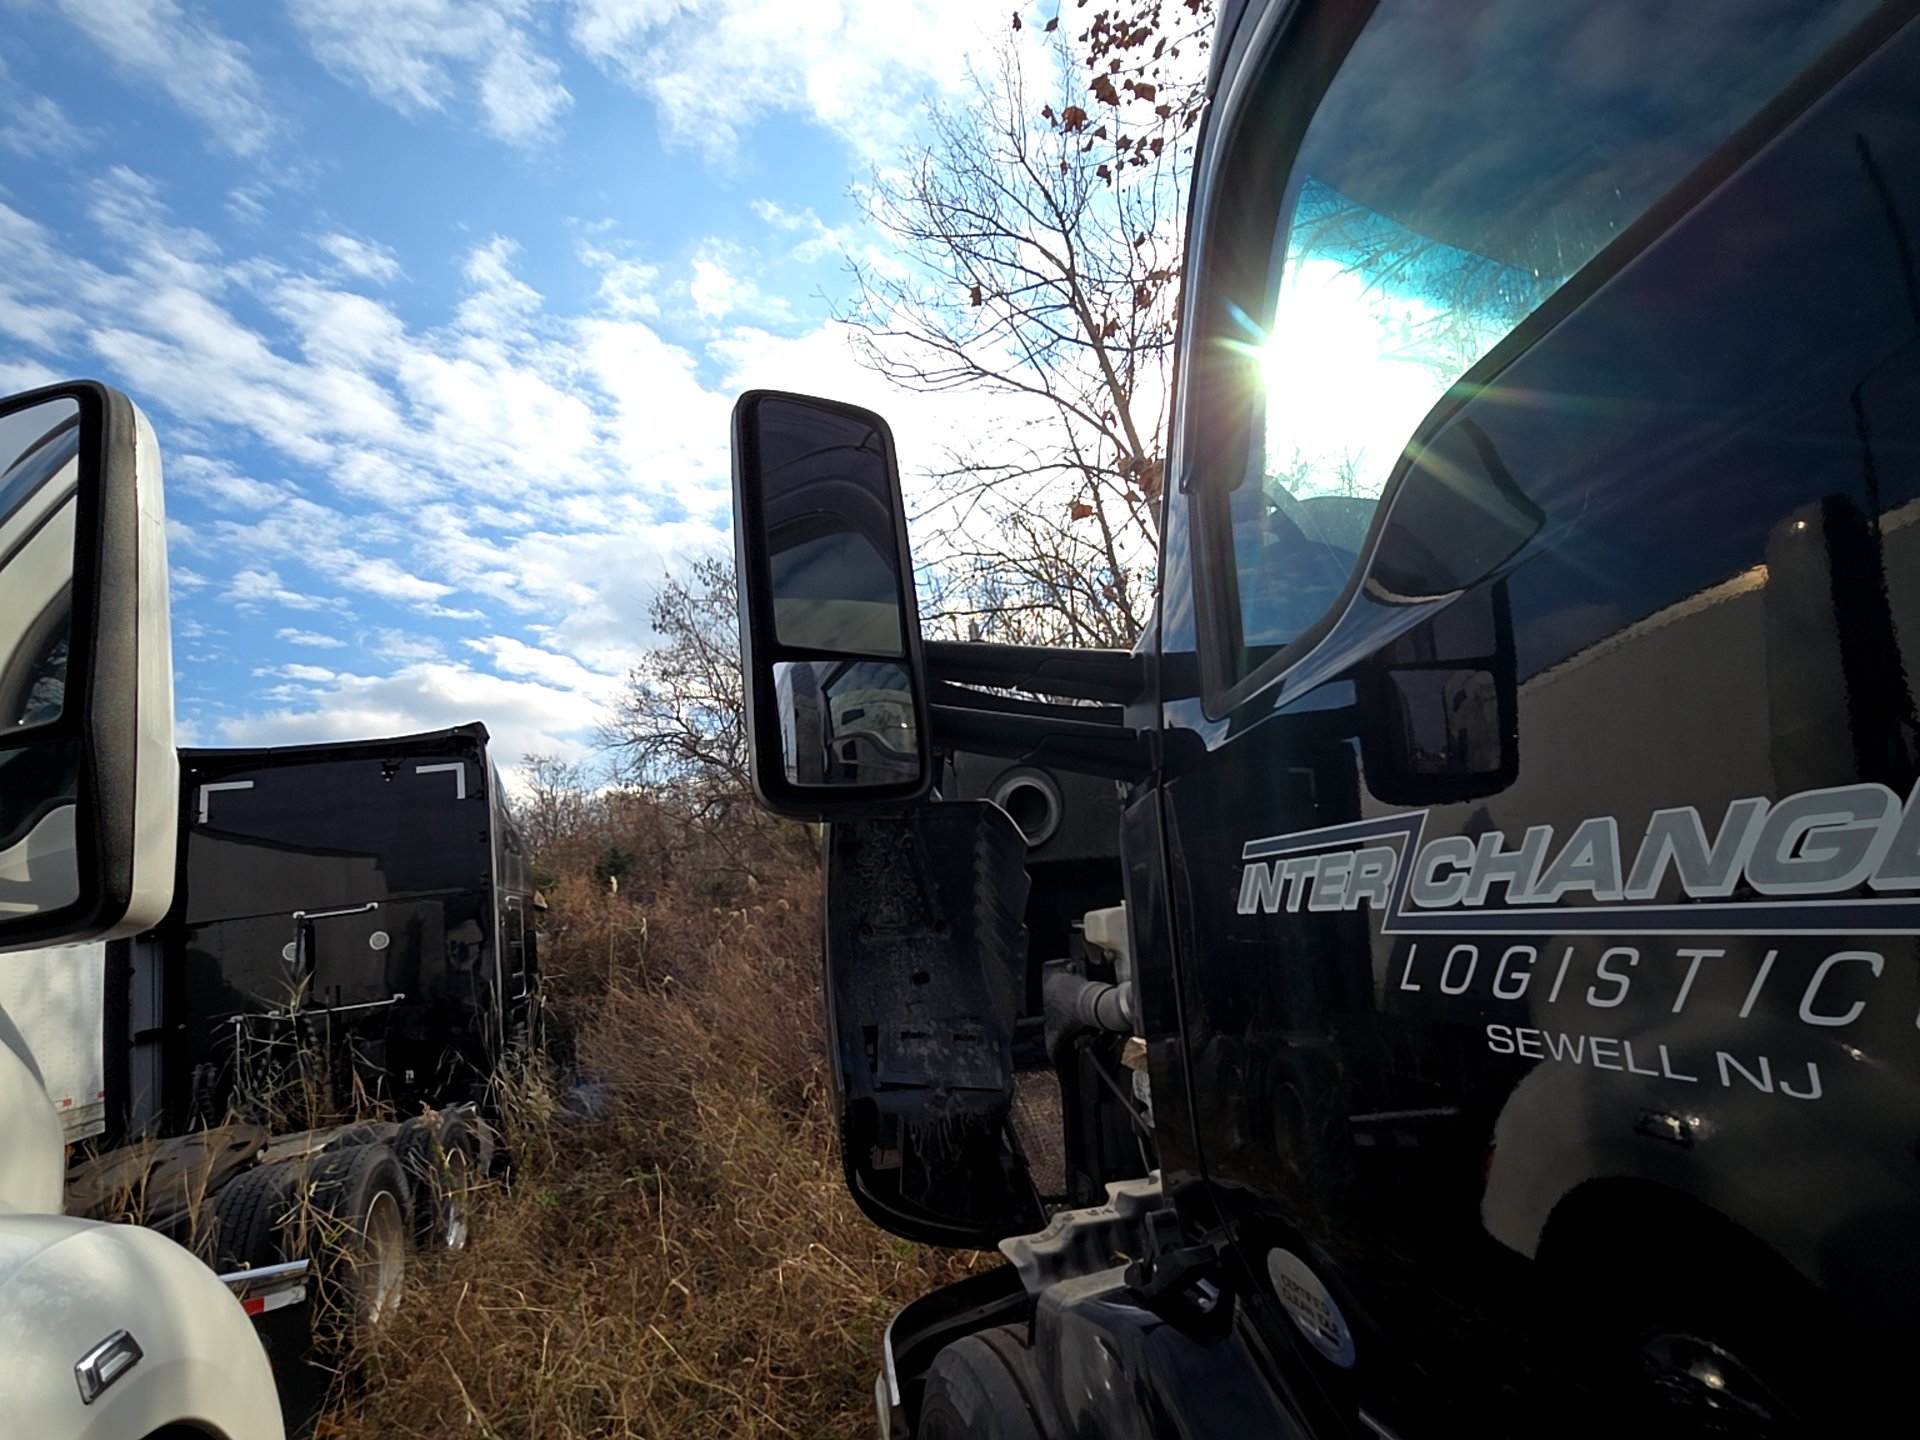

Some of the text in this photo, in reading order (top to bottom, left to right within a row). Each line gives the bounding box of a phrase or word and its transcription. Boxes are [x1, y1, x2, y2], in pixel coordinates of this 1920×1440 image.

[1400, 942, 1920, 1027] LOGISTIC
[1486, 1023, 1822, 1099] SEWELL NJ
